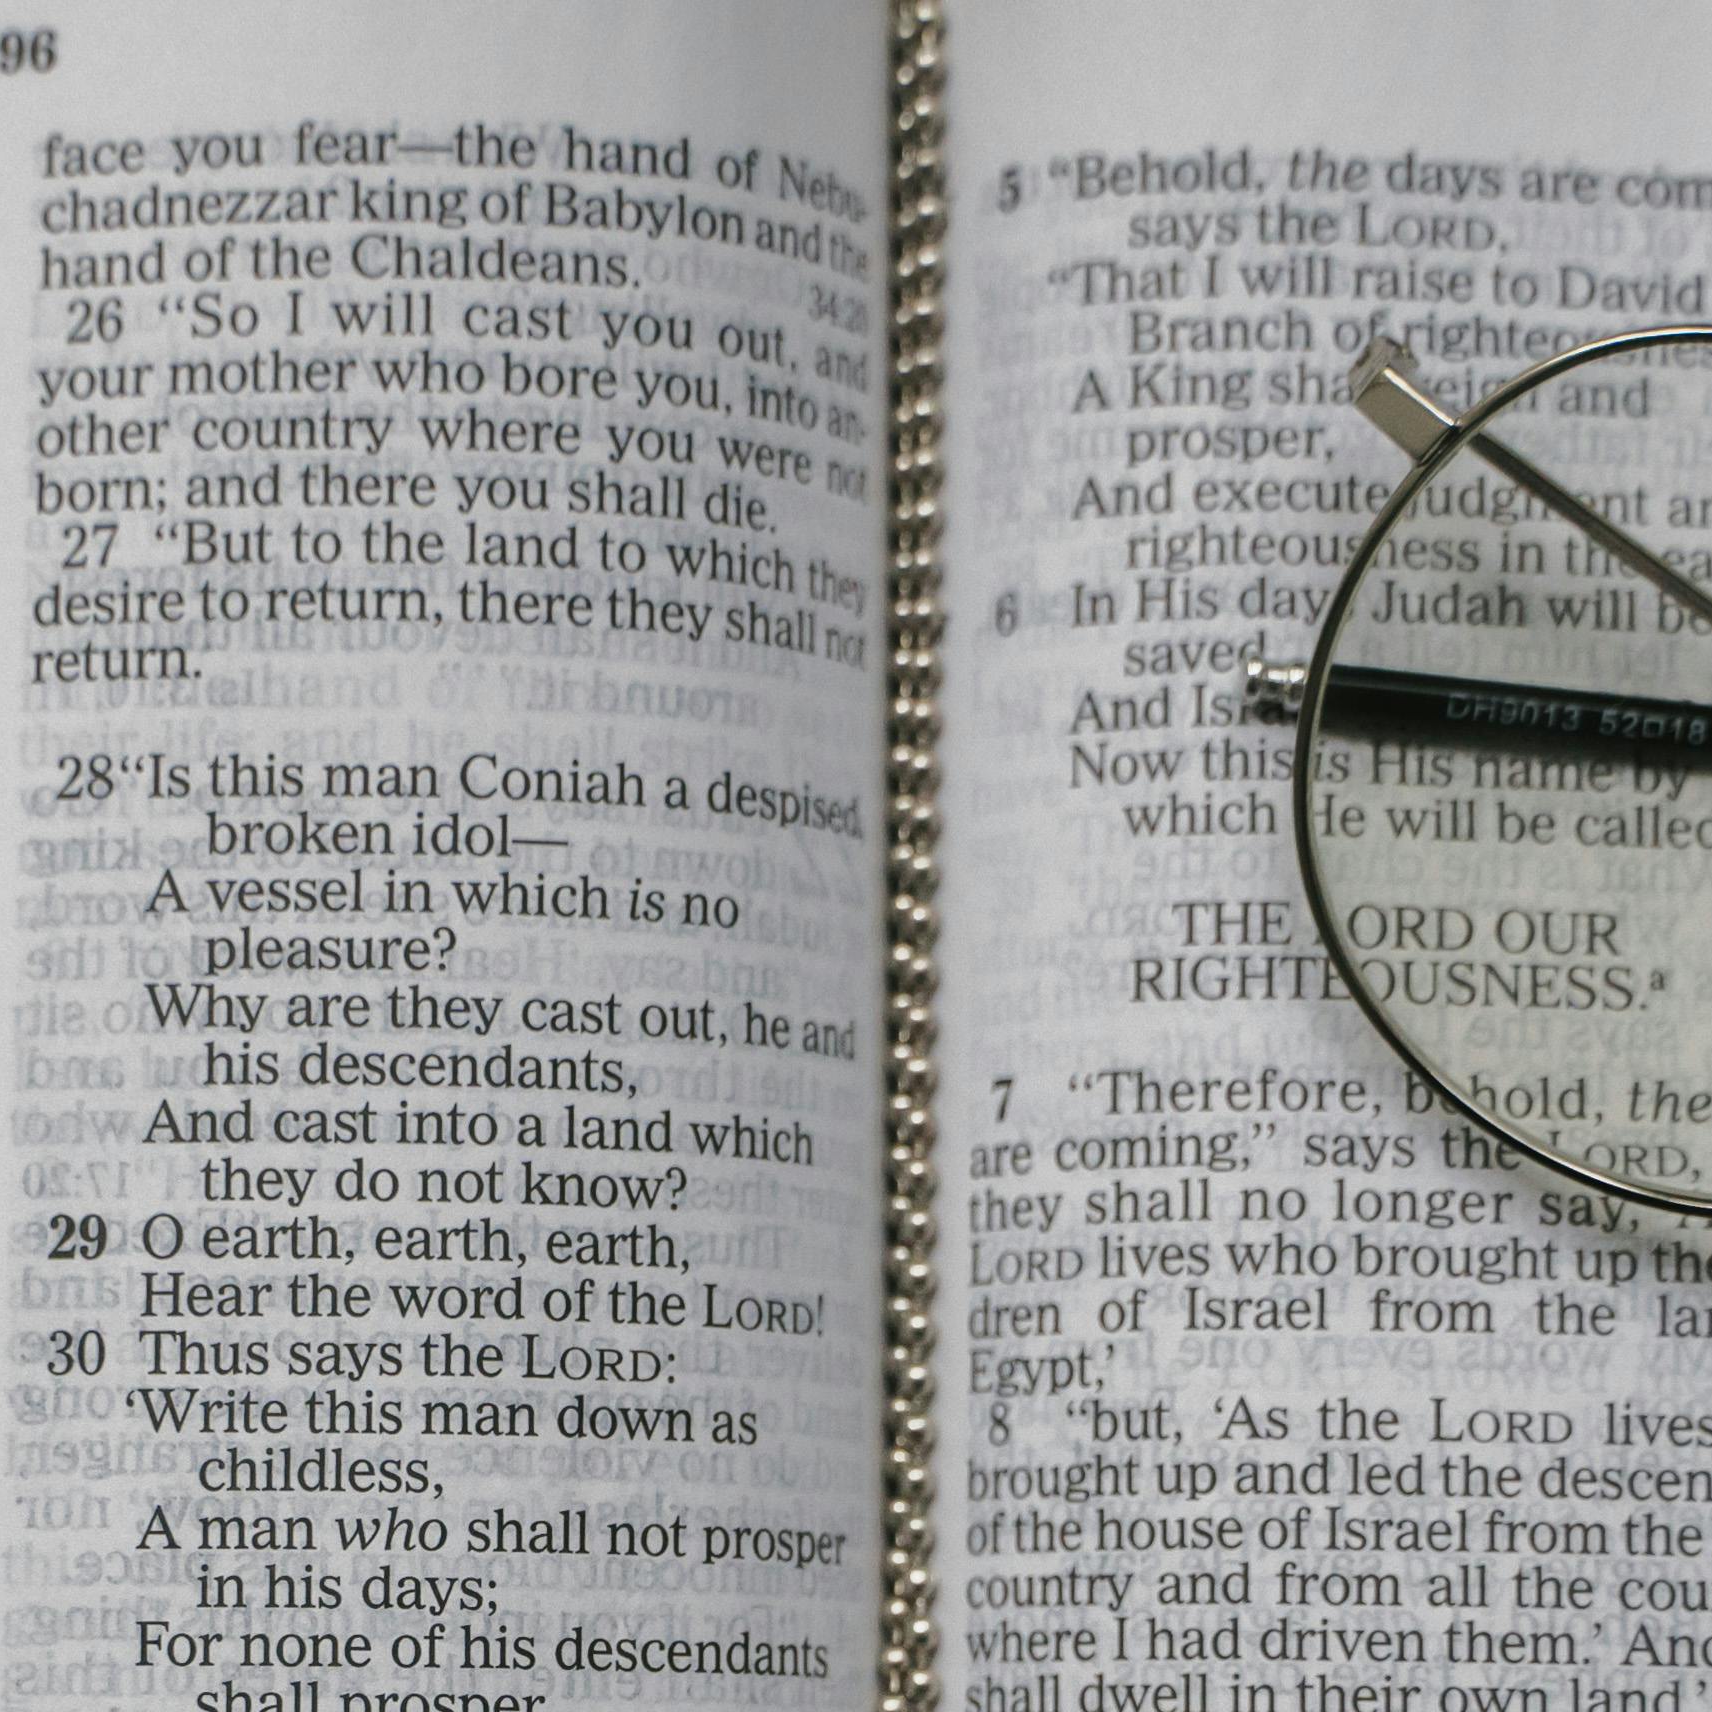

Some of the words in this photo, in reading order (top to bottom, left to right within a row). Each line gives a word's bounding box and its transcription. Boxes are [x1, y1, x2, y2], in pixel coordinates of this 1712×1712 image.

[1128, 206, 1241, 249] says
[1255, 202, 1341, 245] the
[42, 240, 164, 289] hand
[183, 238, 237, 284] of
[251, 237, 331, 281] the
[350, 235, 643, 289] Chaldeans.
[1446, 692, 1582, 733] DH9013
[47, 1215, 108, 1261] 29
[141, 1215, 183, 1261] O
[201, 1215, 356, 1267] earth,
[374, 1217, 528, 1270] earth,
[545, 1223, 691, 1276] earth,
[139, 1272, 274, 1319] Hear
[286, 1272, 372, 1318] the
[387, 1276, 525, 1321] word
[541, 1278, 598, 1323] of
[607, 1280, 687, 1327] the
[702, 1281, 826, 1337] LORD!
[966, 1566, 1135, 1611] country
[1157, 1561, 1252, 1606] and
[1276, 1561, 1404, 1607] from
[1427, 1564, 1490, 1608] all
[1513, 1565, 1595, 1611] the
